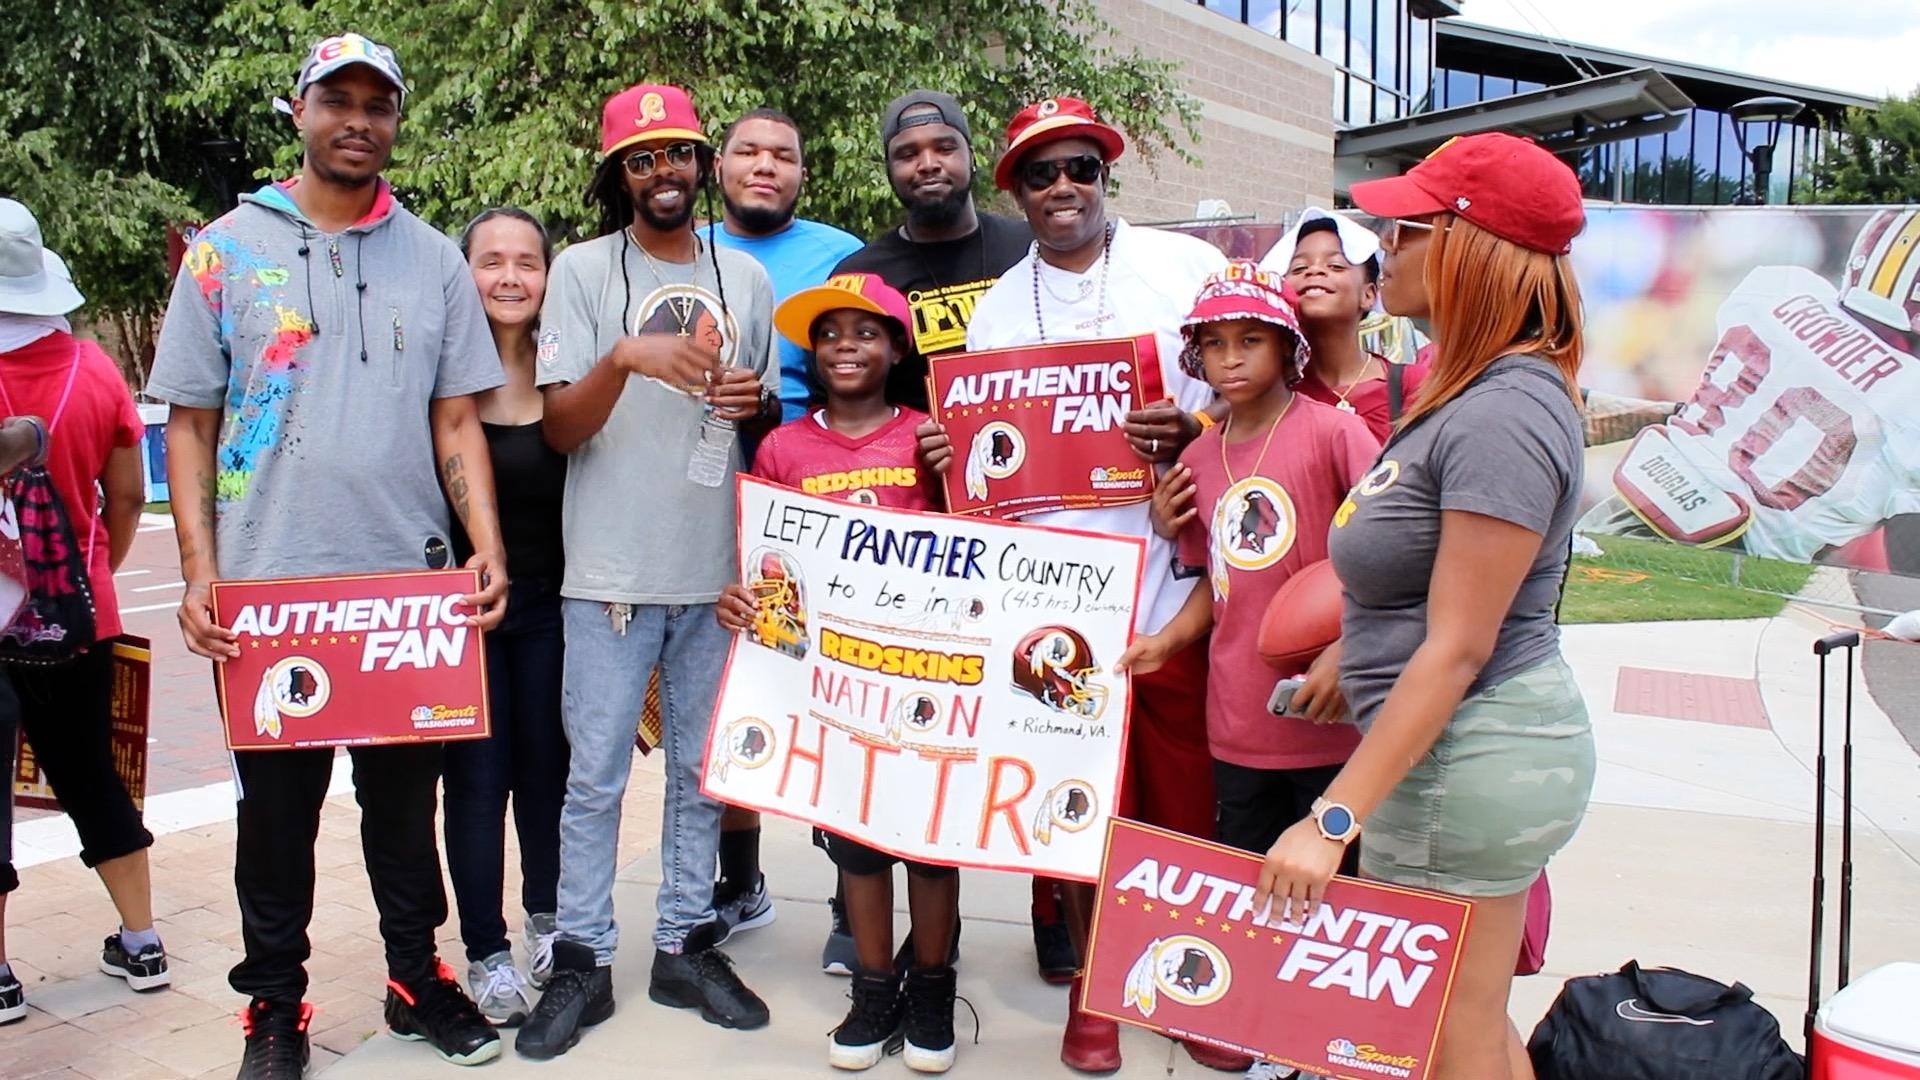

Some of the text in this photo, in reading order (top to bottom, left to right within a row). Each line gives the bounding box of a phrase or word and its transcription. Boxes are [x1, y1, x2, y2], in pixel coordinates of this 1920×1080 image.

[1772, 294, 1903, 393] CROWDER
[943, 361, 1132, 408] AUTHENTIC
[1051, 393, 1131, 433] FAN
[1670, 325, 1858, 511] 80
[802, 467, 917, 494] REDSKINS
[1092, 480, 1144, 489] WASHINGTON
[1106, 467, 1145, 482] Sports
[1639, 455, 1707, 512] DOUGLAS
[763, 500, 839, 548] LEFT
[840, 519, 986, 580] PANTHER
[828, 575, 949, 612] to be in
[230, 593, 469, 636] AUTHENTIC
[360, 626, 467, 672] FAN
[820, 627, 985, 686] REDSKINS
[413, 717, 476, 730] WASHINGTON
[432, 704, 478, 720] Sports
[1023, 717, 1110, 740] Richmond, VA.
[776, 712, 1037, 857] HTTR
[1277, 937, 1434, 1008] FAN
[1208, 1037, 1242, 1052] PICTURES
[1355, 1044, 1419, 1069] Sports
[1327, 1053, 1411, 1079] WASHINGTON
